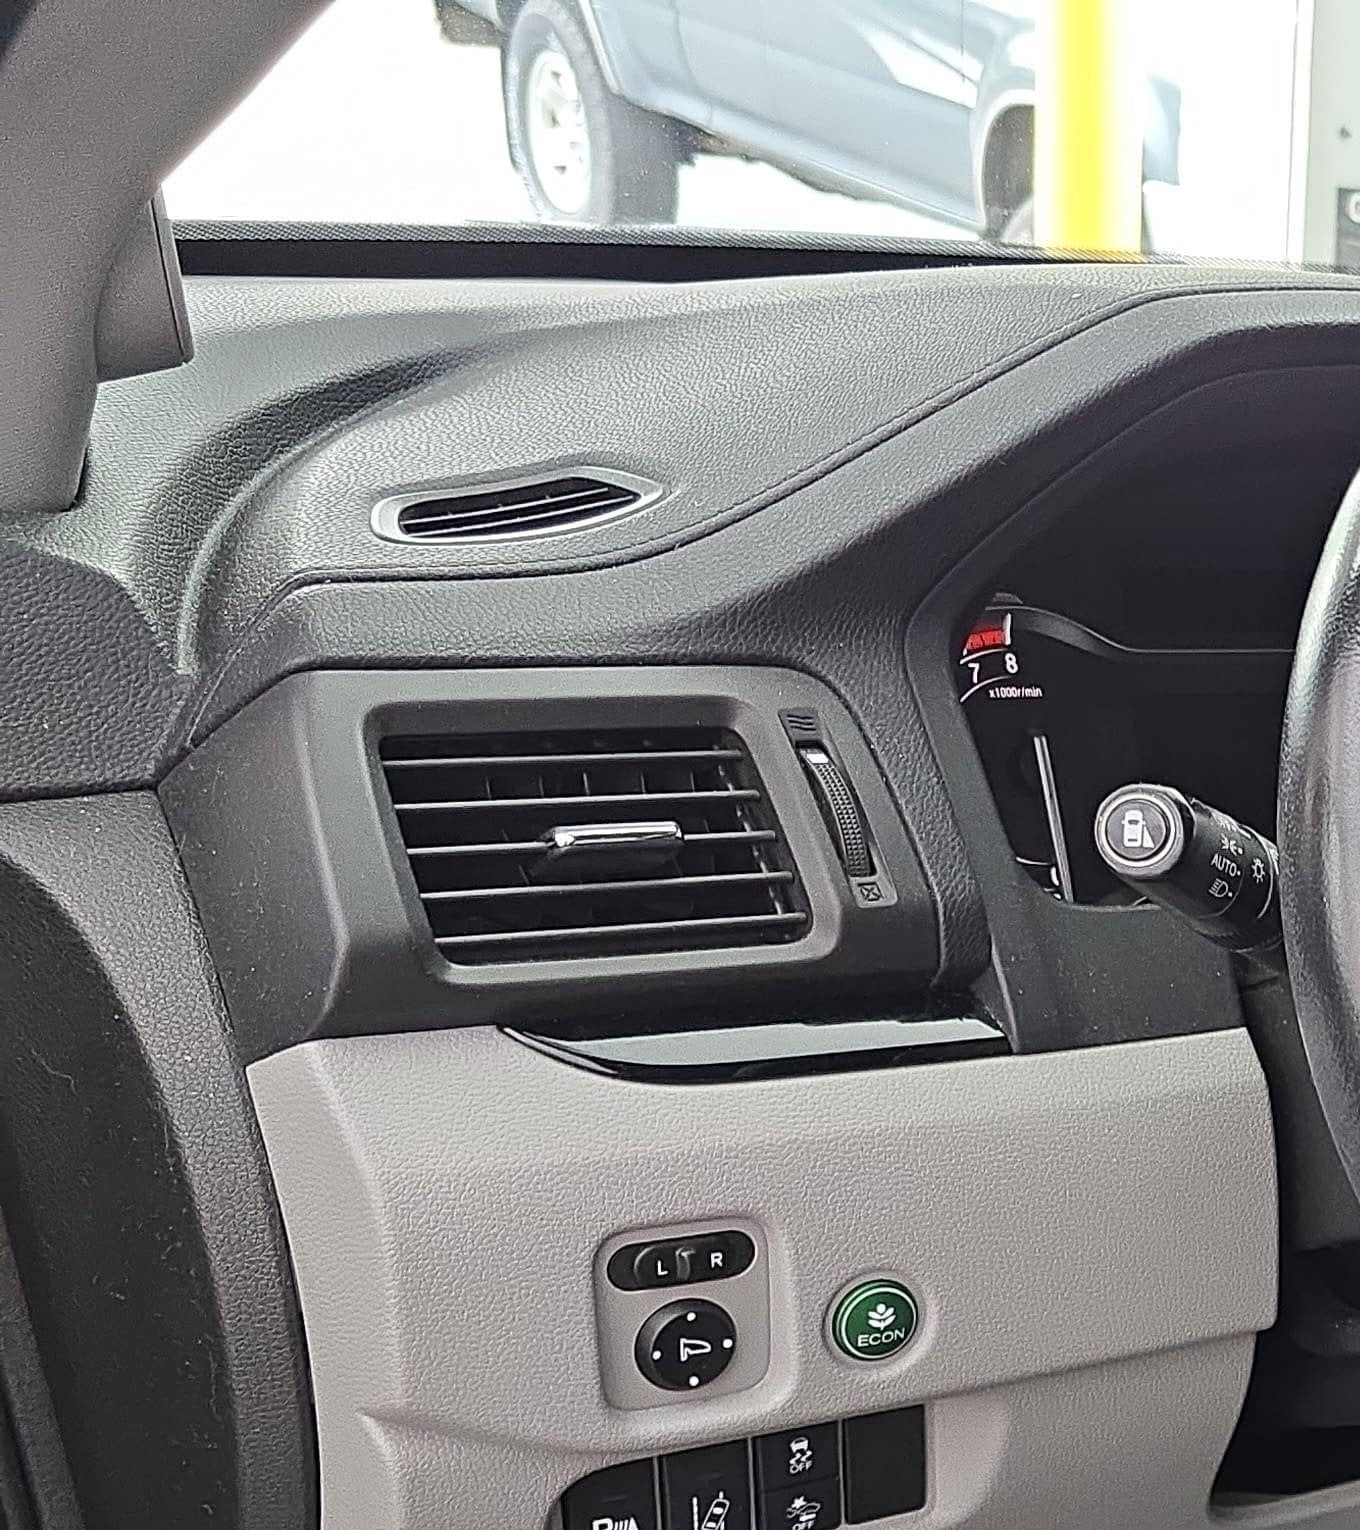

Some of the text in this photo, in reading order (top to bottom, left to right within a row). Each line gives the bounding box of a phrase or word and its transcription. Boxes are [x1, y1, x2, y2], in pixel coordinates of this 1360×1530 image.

[968, 652, 1018, 683] 7 8
[1210, 853, 1237, 877] AUTO
[657, 1252, 723, 1276] L R
[857, 1327, 905, 1347] ECON
[789, 1459, 814, 1473] OFF
